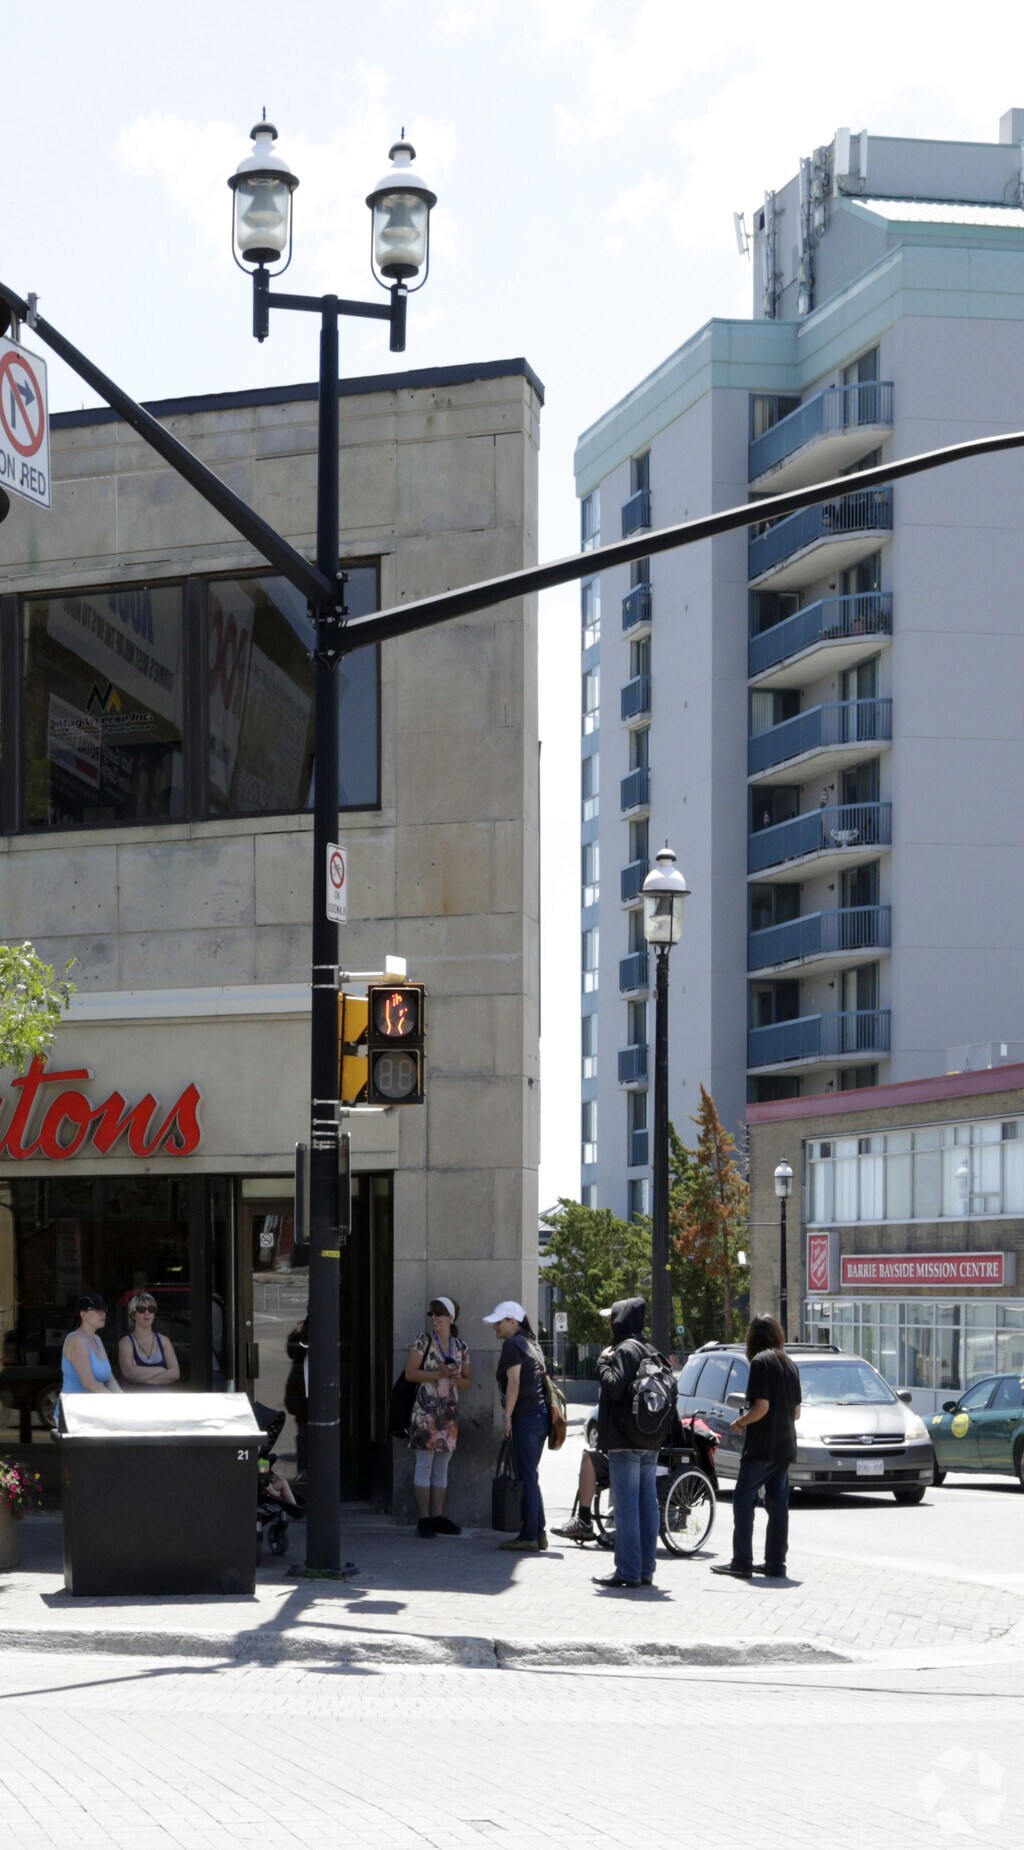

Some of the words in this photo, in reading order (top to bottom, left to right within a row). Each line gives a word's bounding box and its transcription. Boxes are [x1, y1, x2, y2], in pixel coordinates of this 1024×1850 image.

[21, 462, 46, 496] RED
[132, 712, 154, 723] Inc.
[847, 1264, 877, 1278] BARRIE
[879, 1263, 915, 1278] BAYSIDE
[916, 1262, 957, 1277] MISSION
[959, 1261, 999, 1277] CENTRE
[237, 1449, 249, 1460] 21
